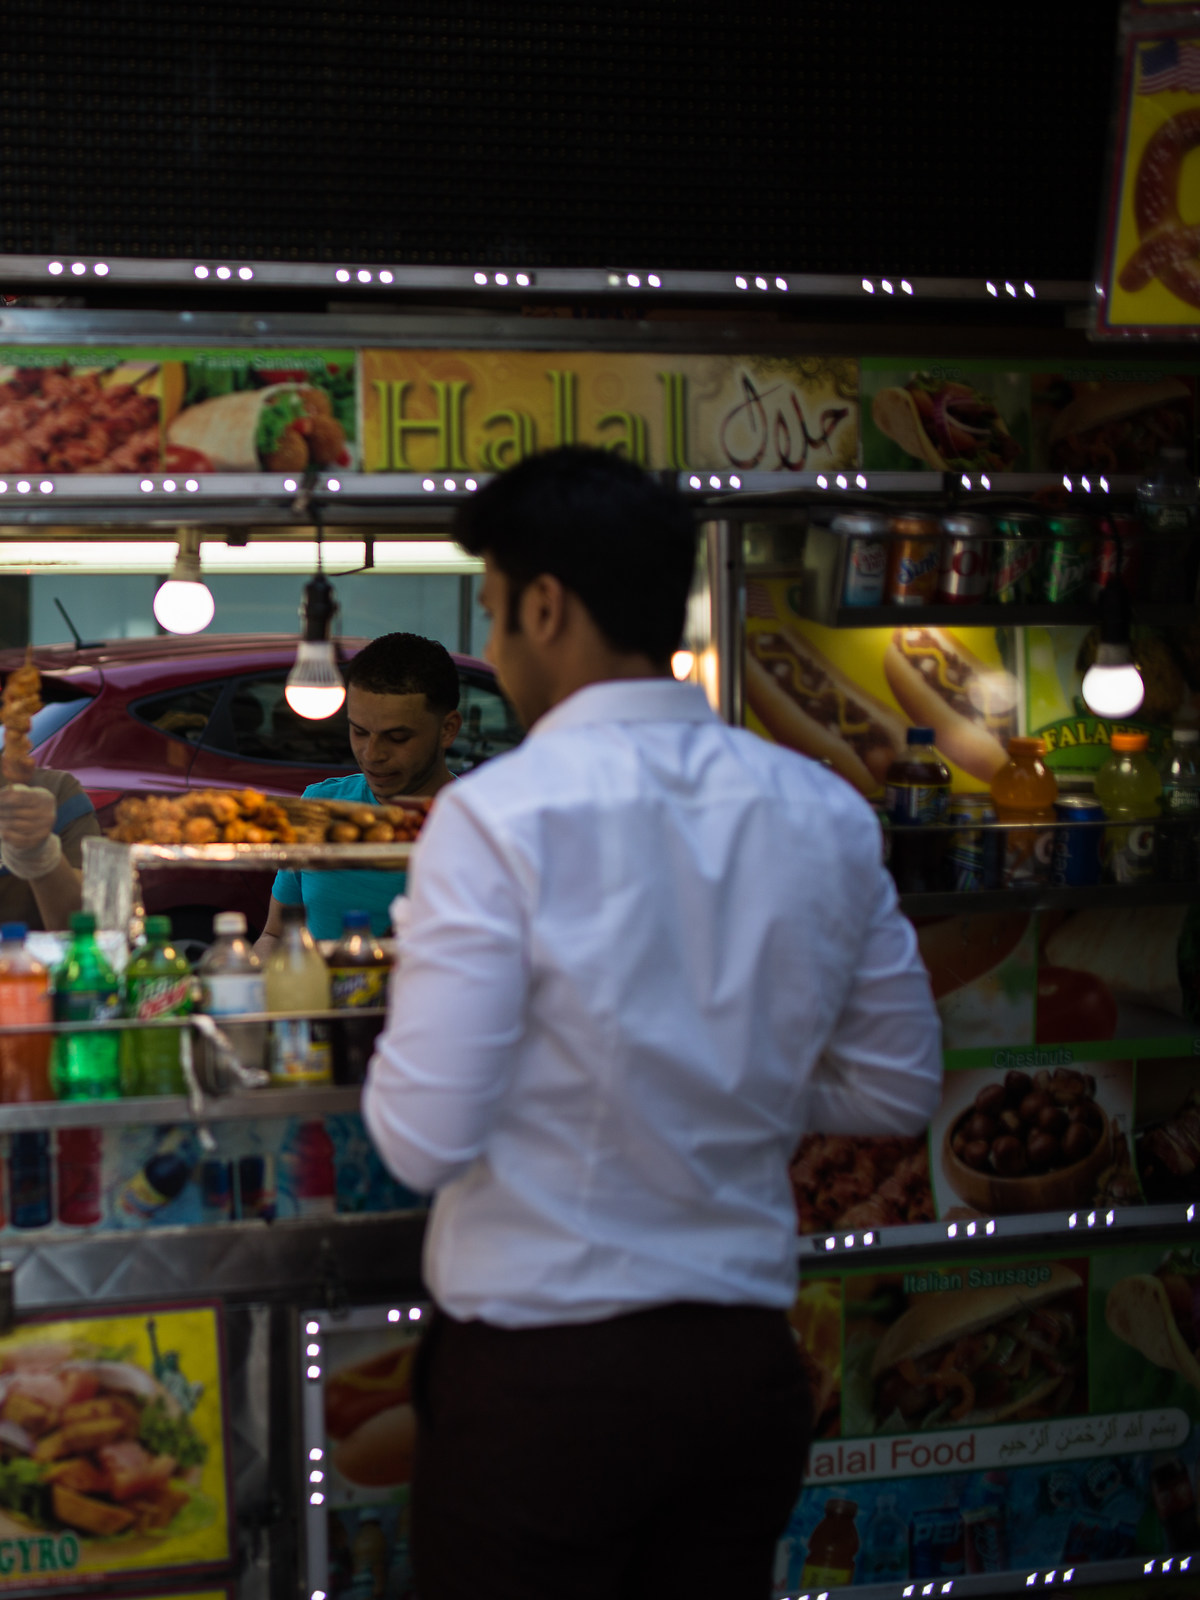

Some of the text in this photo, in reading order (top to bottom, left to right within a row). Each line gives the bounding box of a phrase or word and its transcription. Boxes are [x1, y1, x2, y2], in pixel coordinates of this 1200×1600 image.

[372, 370, 690, 472] Halal
[993, 1047, 1073, 1069] Chestnuts
[903, 1264, 1052, 1295] Italian Sausage
[891, 1433, 976, 1470] Food
[0, 1529, 79, 1575] GYRO
